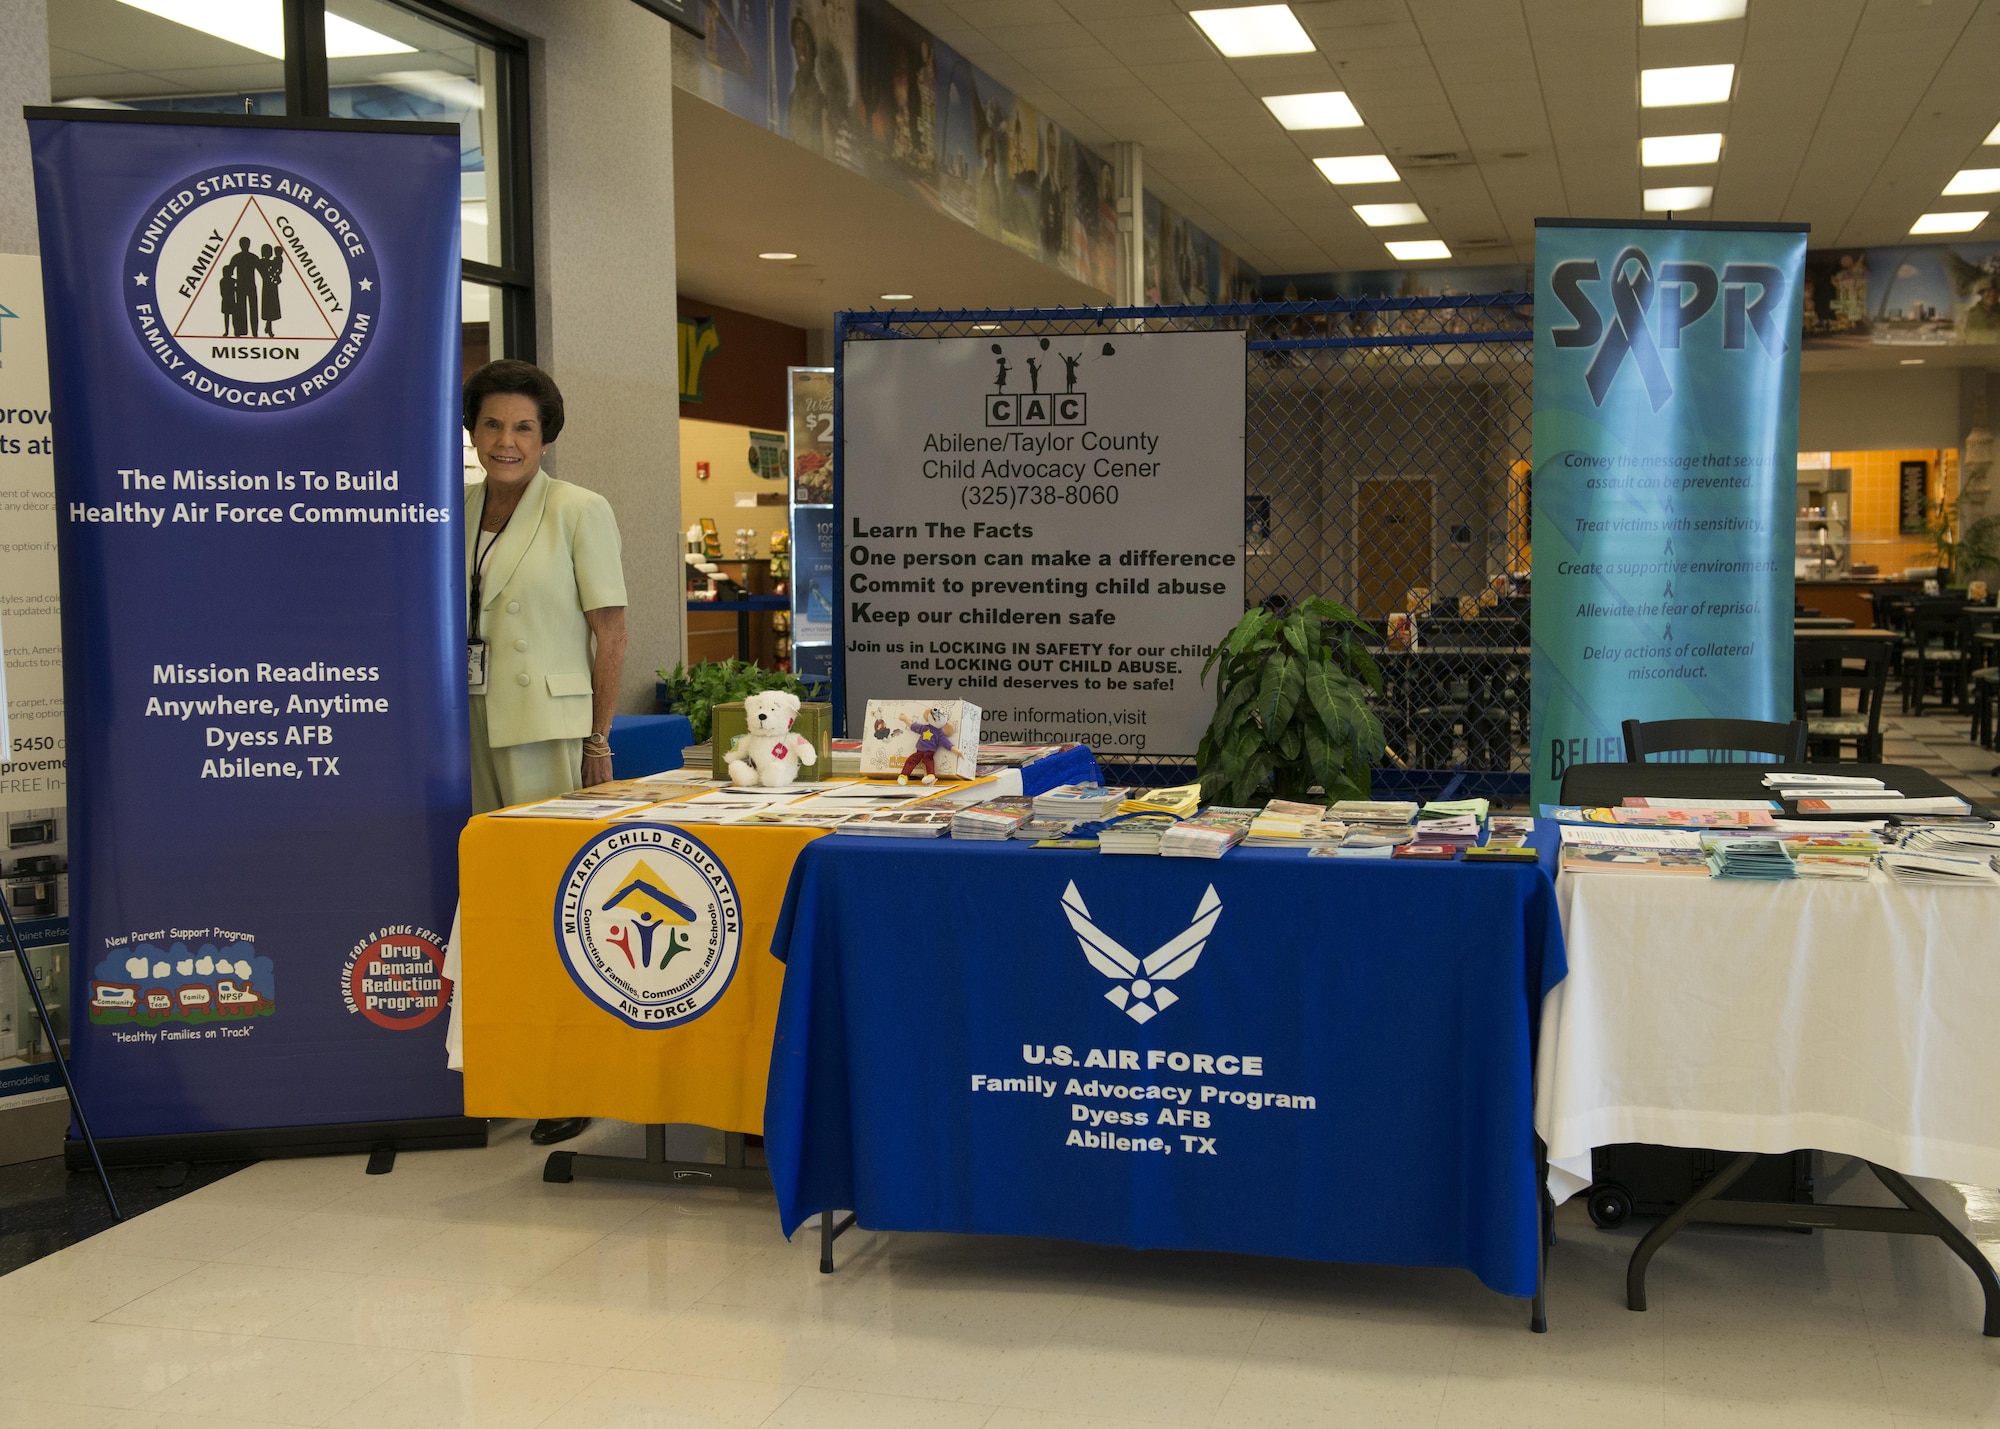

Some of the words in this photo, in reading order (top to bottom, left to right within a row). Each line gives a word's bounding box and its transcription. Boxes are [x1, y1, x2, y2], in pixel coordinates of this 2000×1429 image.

[138, 190, 195, 256] UNITED
[196, 172, 273, 197] STATES
[276, 179, 313, 204] AIR
[313, 197, 365, 258] FORCE
[178, 228, 225, 299] FAMILY
[276, 215, 343, 314] COMMUNITY
[136, 303, 185, 370] FAMILY
[181, 370, 297, 406] ADVOCACY
[301, 313, 371, 397] PROGRAM
[211, 346, 300, 360] MISSION
[28, 436, 52, 454] at
[923, 432, 1074, 456] Abilene/Taylor
[1081, 432, 1159, 455] County
[922, 459, 975, 479] Child
[981, 458, 1086, 481] Advocacy
[1093, 458, 1161, 478] Cener
[1564, 454, 1615, 470] Convey
[1617, 454, 1639, 467] the
[1641, 456, 1701, 470] message
[1702, 453, 1731, 467] that
[118, 469, 166, 491] The
[173, 470, 271, 491] Mission
[276, 470, 296, 491] Is
[300, 470, 329, 491] To
[336, 469, 399, 491] Build
[1587, 476, 1634, 489] assault
[1637, 479, 1660, 488] can
[1663, 476, 1680, 488] be
[1682, 475, 1754, 491] prevented.
[20, 490, 30, 498] of
[960, 485, 1119, 510] (325)738-8060
[5, 503, 21, 512] any
[23, 502, 49, 511] décor
[69, 502, 164, 529] Healthy
[172, 503, 209, 523] Air
[216, 502, 283, 523] Force
[289, 503, 451, 524] Communities
[852, 517, 918, 539] Learn
[925, 522, 966, 539] The
[973, 522, 1034, 539] Facts
[1575, 518, 1609, 532] Treat
[1612, 518, 1658, 531] victims
[1662, 518, 1691, 531] with
[1693, 516, 1764, 533] sensitivity.
[12, 542, 42, 552] option
[44, 542, 51, 550] if
[850, 545, 896, 566] One
[903, 551, 977, 569] person
[983, 552, 1024, 567] can
[1031, 550, 1091, 567] make
[1098, 553, 1112, 567] a
[1119, 550, 1236, 567] difference
[1558, 561, 1603, 575] Create
[1606, 564, 1614, 574] a
[1617, 560, 1687, 576] supportive
[1690, 560, 1778, 574] environment.
[850, 573, 935, 594] Commit
[943, 579, 964, 594] to
[971, 576, 1088, 598] preventing
[1095, 578, 1149, 595] child
[1157, 579, 1226, 595] abuse
[26, 594, 43, 603] and
[13, 606, 51, 616] updated
[851, 602, 910, 626] Keep
[917, 609, 952, 624] our
[959, 607, 1061, 625] childeren
[1069, 608, 1116, 625] safe
[1576, 604, 1634, 617] Alleviate
[1637, 603, 1659, 616] the
[1660, 602, 1689, 616] fear
[1691, 601, 1706, 615] of
[1707, 601, 1761, 617] reprisal.
[848, 640, 880, 652] Join
[886, 643, 904, 652] us
[910, 641, 924, 653] in
[930, 641, 1006, 655] LOCKING
[1012, 642, 1030, 654] IN
[1036, 642, 1103, 656] SAFETY
[1108, 643, 1135, 656] for
[1137, 646, 1165, 657] our
[1583, 646, 1621, 662] Delay
[1624, 645, 1671, 659] actions
[1675, 644, 1690, 659] of
[1691, 642, 1754, 657] collateral
[40, 658, 50, 667] to
[900, 658, 929, 670] and
[935, 658, 1012, 671] LOCKING
[1017, 659, 1054, 672] OUT
[1059, 659, 1112, 673] CHILD
[1117, 661, 1182, 674] ABUSE.
[1628, 665, 1708, 680] misconduct.
[153, 663, 249, 685] Mission
[256, 662, 380, 684] Readiness
[907, 674, 953, 690] Every
[958, 675, 998, 688] child
[1003, 676, 1079, 689] deserves
[1084, 678, 1102, 690] to
[1107, 678, 1127, 690] be
[1133, 678, 1174, 691] safe!
[16, 698, 48, 708] carpet,
[145, 695, 280, 721] Anywhere,
[286, 694, 389, 719] Anytime
[206, 726, 278, 751] Dyess
[284, 725, 333, 745] AFB
[200, 757, 303, 780] Abilene,
[308, 757, 340, 776] TX
[1, 778, 42, 794] FREE
[564, 848, 602, 934] MILITARY
[608, 831, 662, 850] CHILD
[671, 837, 737, 933] EDUCATION
[380, 924, 412, 938] DRUG
[708, 902, 719, 946] Schools
[105, 936, 128, 948] New
[131, 929, 165, 942] Parent
[170, 927, 210, 940] Support
[214, 927, 255, 942] Program
[369, 932, 378, 943] A
[415, 927, 443, 945] FREE
[583, 908, 605, 969] Connecting
[349, 939, 369, 960] FOR
[380, 943, 421, 960] Drug
[703, 949, 716, 968] and
[369, 960, 433, 976] Demand
[340, 961, 359, 1014] WORKING
[361, 977, 441, 993] Reduction
[604, 966, 640, 999] Families,
[642, 967, 705, 1000] Communities
[97, 999, 134, 1007] Community
[220, 992, 244, 1001] NPSP
[366, 995, 438, 1011] Program
[619, 1000, 639, 1018] AIR
[644, 997, 697, 1020] FORCE
[161, 1029, 201, 1041] Families
[205, 1031, 217, 1039] on
[1022, 1043, 1080, 1067] U.S.
[1084, 1049, 1141, 1071] AIR
[1147, 1050, 1264, 1077] FORCE
[971, 1074, 1057, 1097] Family
[1064, 1078, 1192, 1105] Advocacy
[1200, 1085, 1316, 1110] Program
[1071, 1104, 1149, 1126] Dyess
[1157, 1108, 1212, 1129] AFB
[1066, 1129, 1171, 1155] Abilene,
[1180, 1135, 1218, 1155] TX
